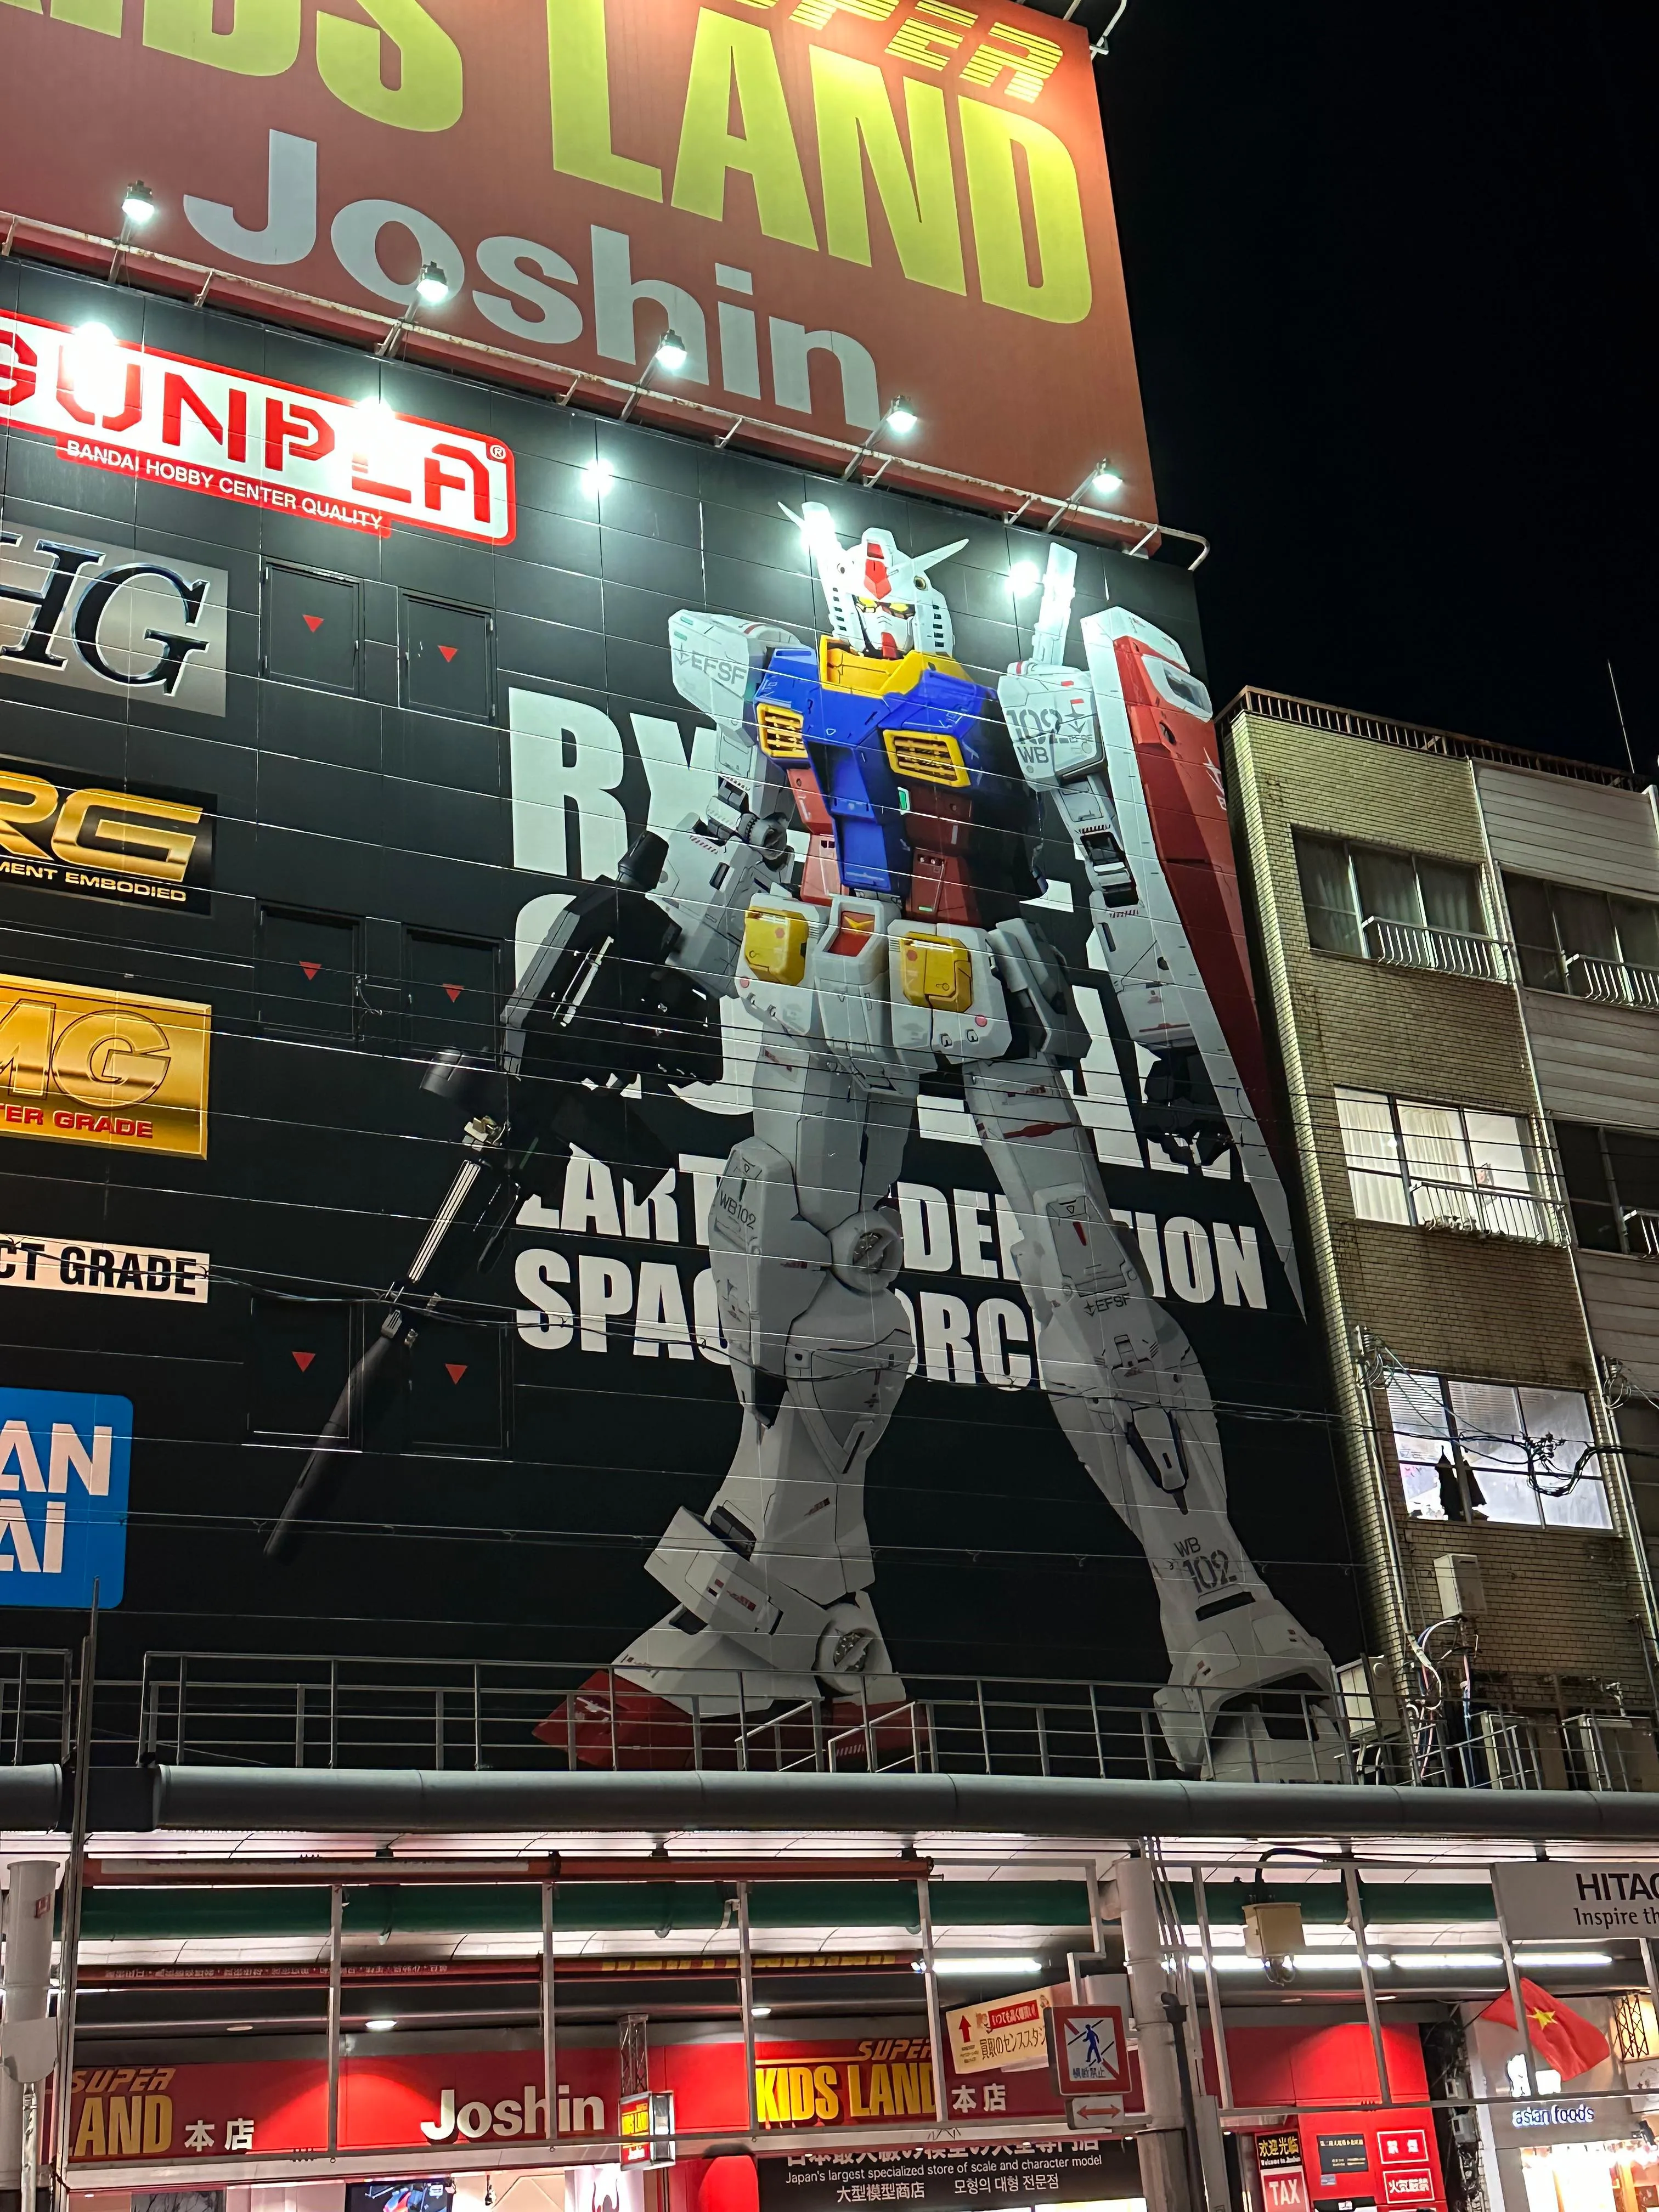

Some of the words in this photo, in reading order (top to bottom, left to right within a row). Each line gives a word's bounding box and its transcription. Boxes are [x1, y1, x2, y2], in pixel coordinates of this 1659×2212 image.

[545, 0, 1093, 324] LAND
[183, 129, 881, 431] Joshin
[66, 439, 140, 471] BANDAI
[145, 459, 214, 488] HOBBY
[218, 476, 297, 510] CENTER
[301, 497, 383, 530] QUALITY
[691, 650, 749, 685] EFSF
[1018, 746, 1049, 765] WB
[65, 871, 187, 902] EMBODIED
[0, 1103, 43, 1125] ER
[53, 1110, 153, 1139] GRADE
[719, 1190, 757, 1231] WB102
[60, 1246, 197, 1296] GRADE
[1173, 1537, 1201, 1557] WB
[1182, 1550, 1238, 1593] 102
[1573, 1906, 1639, 1930] Inspire
[71, 2067, 176, 2094] SUPER
[755, 2064, 839, 2123] KIDS
[847, 2062, 937, 2118] LAND
[420, 2085, 605, 2141] Joshin
[952, 2084, 1007, 2114] 本店
[67, 2094, 173, 2157] AND
[184, 2118, 255, 2152] 本店
[786, 2170, 826, 2185] Japan's
[828, 2169, 865, 2183] largest
[868, 2164, 924, 2181] specialized
[927, 2165, 954, 2176] store
[957, 2162, 968, 2174] of
[971, 2160, 997, 2173] scale
[1000, 2159, 1019, 2171] and
[1021, 2158, 1069, 2170] character
[1072, 2154, 1103, 2166] model
[954, 2177, 991, 2194] 모형의
[994, 2175, 1019, 2193] 대형
[1023, 2173, 1059, 2191] 전문점
[836, 2181, 925, 2203] 大型模型商店
[1268, 2179, 1301, 2207] TAX
